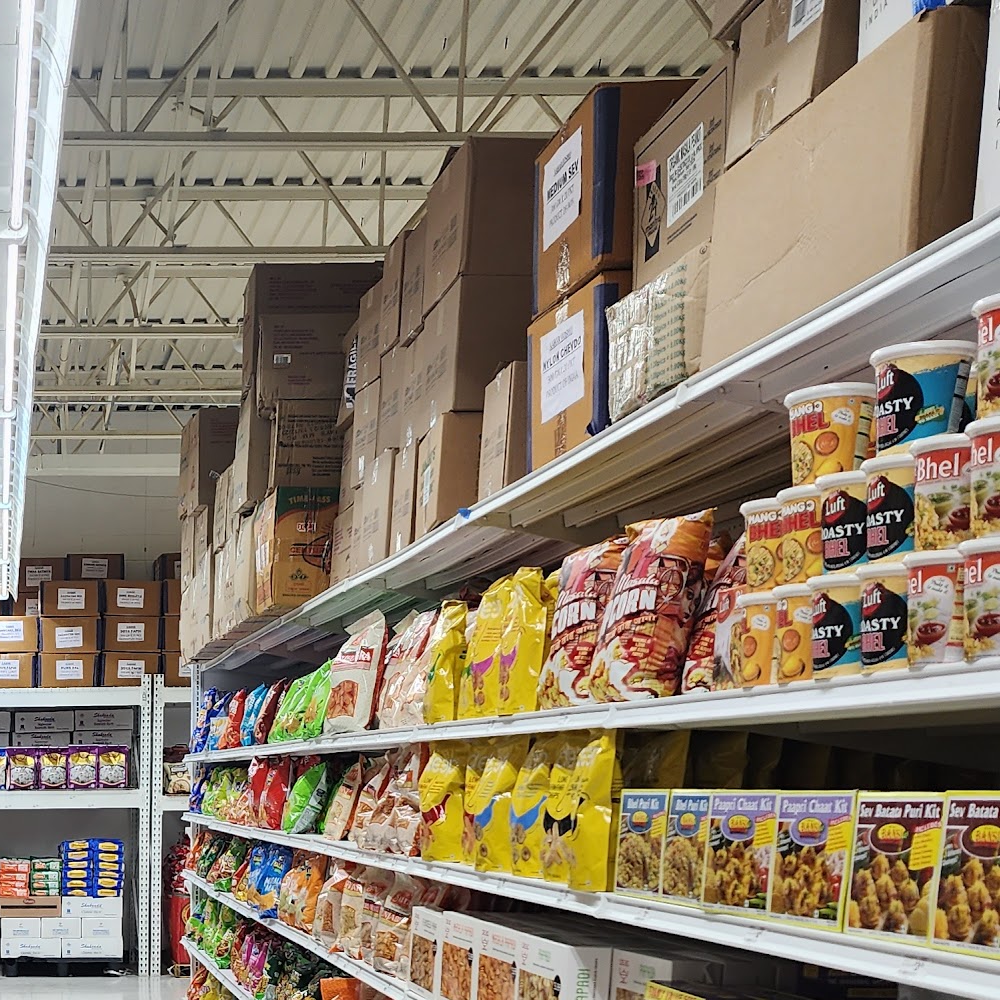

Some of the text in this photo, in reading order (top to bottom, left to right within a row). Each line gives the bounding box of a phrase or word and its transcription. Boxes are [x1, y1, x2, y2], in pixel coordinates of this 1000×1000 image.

[546, 171, 568, 201] MEDIUM
[568, 158, 579, 180] SEV
[560, 336, 582, 359] CHEVDO
[877, 368, 896, 395] Luft
[971, 438, 994, 466] hel
[917, 452, 960, 482] Bhel
[868, 481, 887, 503] Luft
[825, 495, 846, 516] Luft
[867, 508, 904, 529] OASTY
[749, 521, 781, 543] BHE
[616, 573, 660, 592] Masala
[908, 571, 923, 595] el
[557, 588, 598, 606] Masala
[862, 588, 882, 609] Luft
[812, 624, 844, 640] ASTY
[860, 616, 901, 633] OASTY
[650, 797, 660, 811] Kit
[713, 797, 773, 815] Paapri Chaat Kit
[781, 798, 848, 815] Paapri Chaat Kit
[859, 803, 942, 818] Sev Batata Puri Kit
[949, 802, 999, 819] Sev Batata
